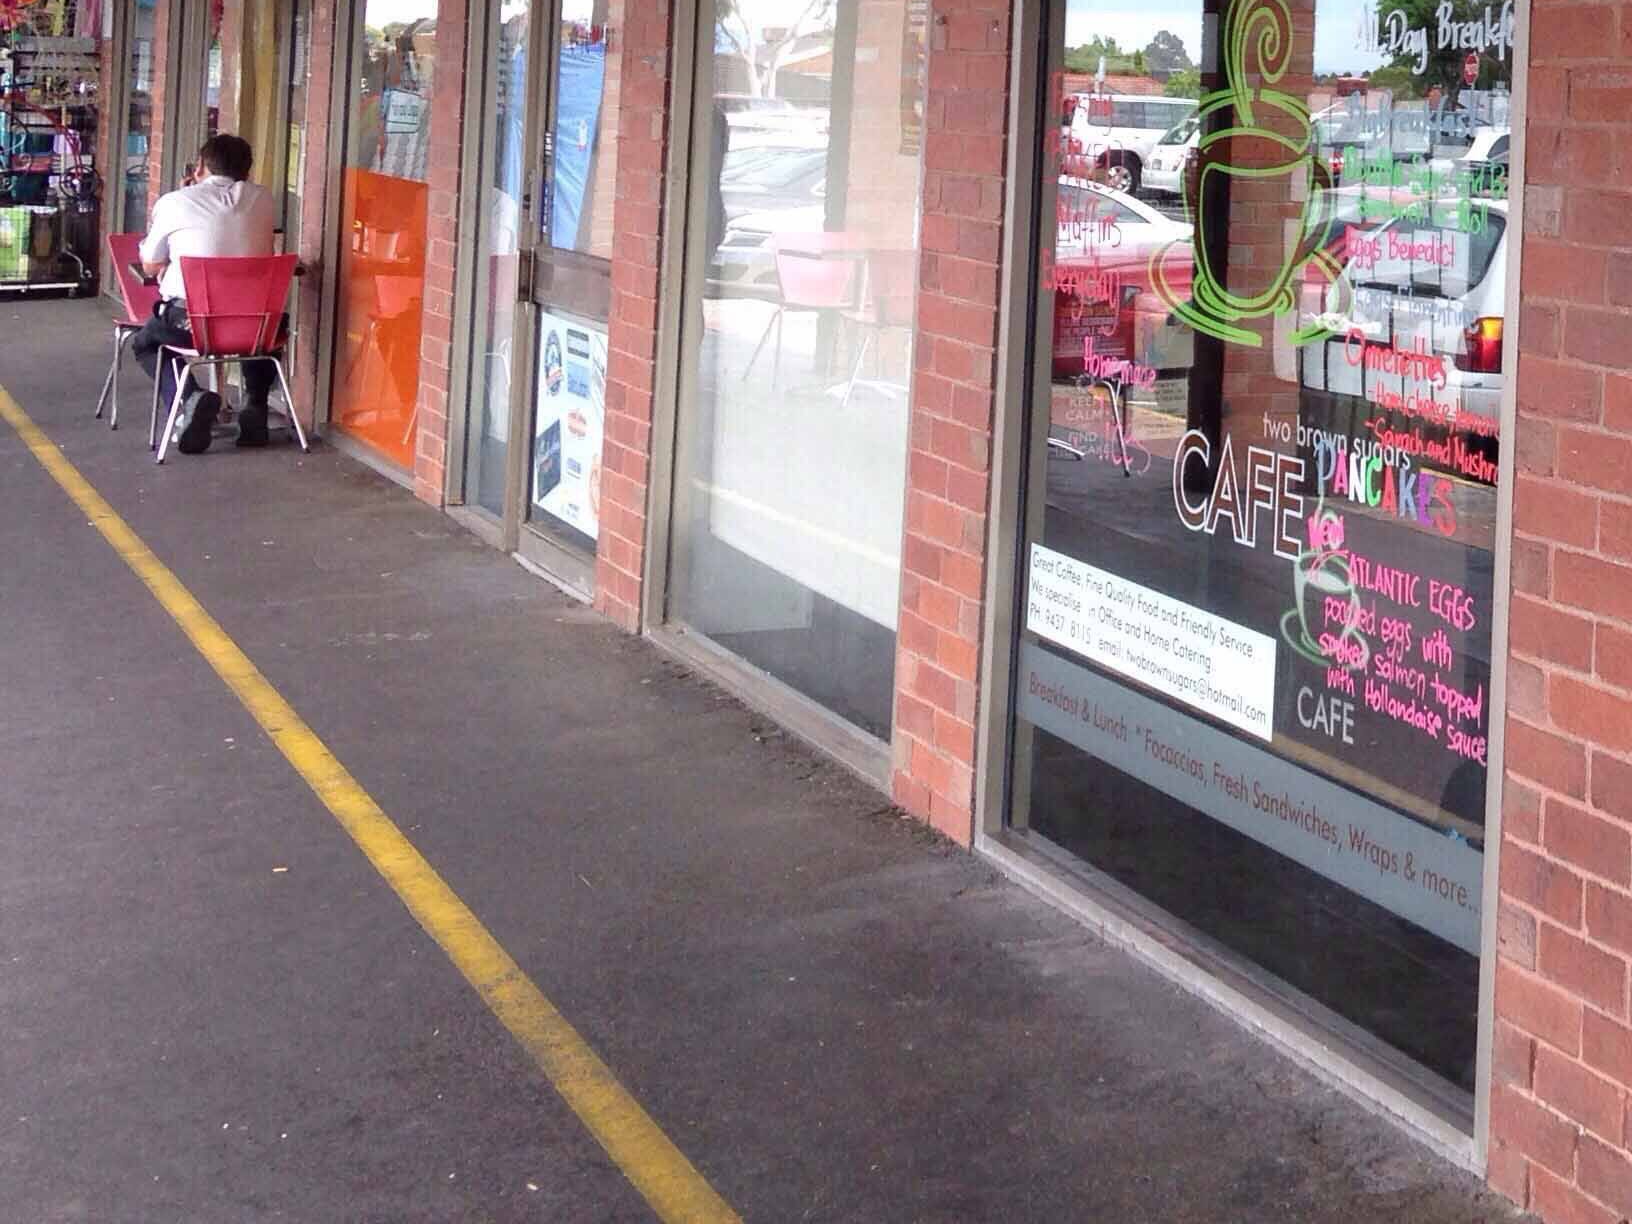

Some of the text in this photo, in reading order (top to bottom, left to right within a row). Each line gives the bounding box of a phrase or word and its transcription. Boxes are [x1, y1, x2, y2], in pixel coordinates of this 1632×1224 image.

[1384, 8, 1429, 75] Day
[1388, 226, 1457, 267] Benedict
[1262, 411, 1411, 473] two brown sugars
[1172, 429, 1305, 562] CAFE
[1313, 439, 1457, 537] PANCAKES
[1031, 577, 1043, 595] We
[1044, 587, 1081, 614] specialise
[1098, 605, 1123, 631] Office
[1125, 618, 1141, 640] and
[1143, 624, 1170, 651] Home
[1032, 551, 1054, 571] Great
[1055, 561, 1083, 589] Coffee,
[1086, 573, 1103, 595] Fine
[1105, 581, 1136, 611] Quality
[1137, 593, 1159, 617] Food
[1161, 606, 1178, 627] and
[1180, 609, 1217, 645] Friendly
[1348, 554, 1475, 631] ATLANTIC EGGS
[1381, 618, 1412, 662] eggs
[1422, 630, 1452, 672] with
[1126, 647, 1268, 726] twobrownsugars@hotmail.com
[1297, 686, 1355, 745] CAFE
[1327, 665, 1355, 697] with
[1364, 679, 1442, 739] Hollandaise
[1430, 673, 1482, 728] topped
[1030, 671, 1079, 717] Breakfast
[1081, 701, 1090, 723] &
[1093, 703, 1128, 742] Lunch
[1213, 761, 1249, 804] Fresh
[1252, 781, 1343, 853] Sandwiches,
[1349, 823, 1398, 877] Wraps
[1403, 852, 1416, 881] &
